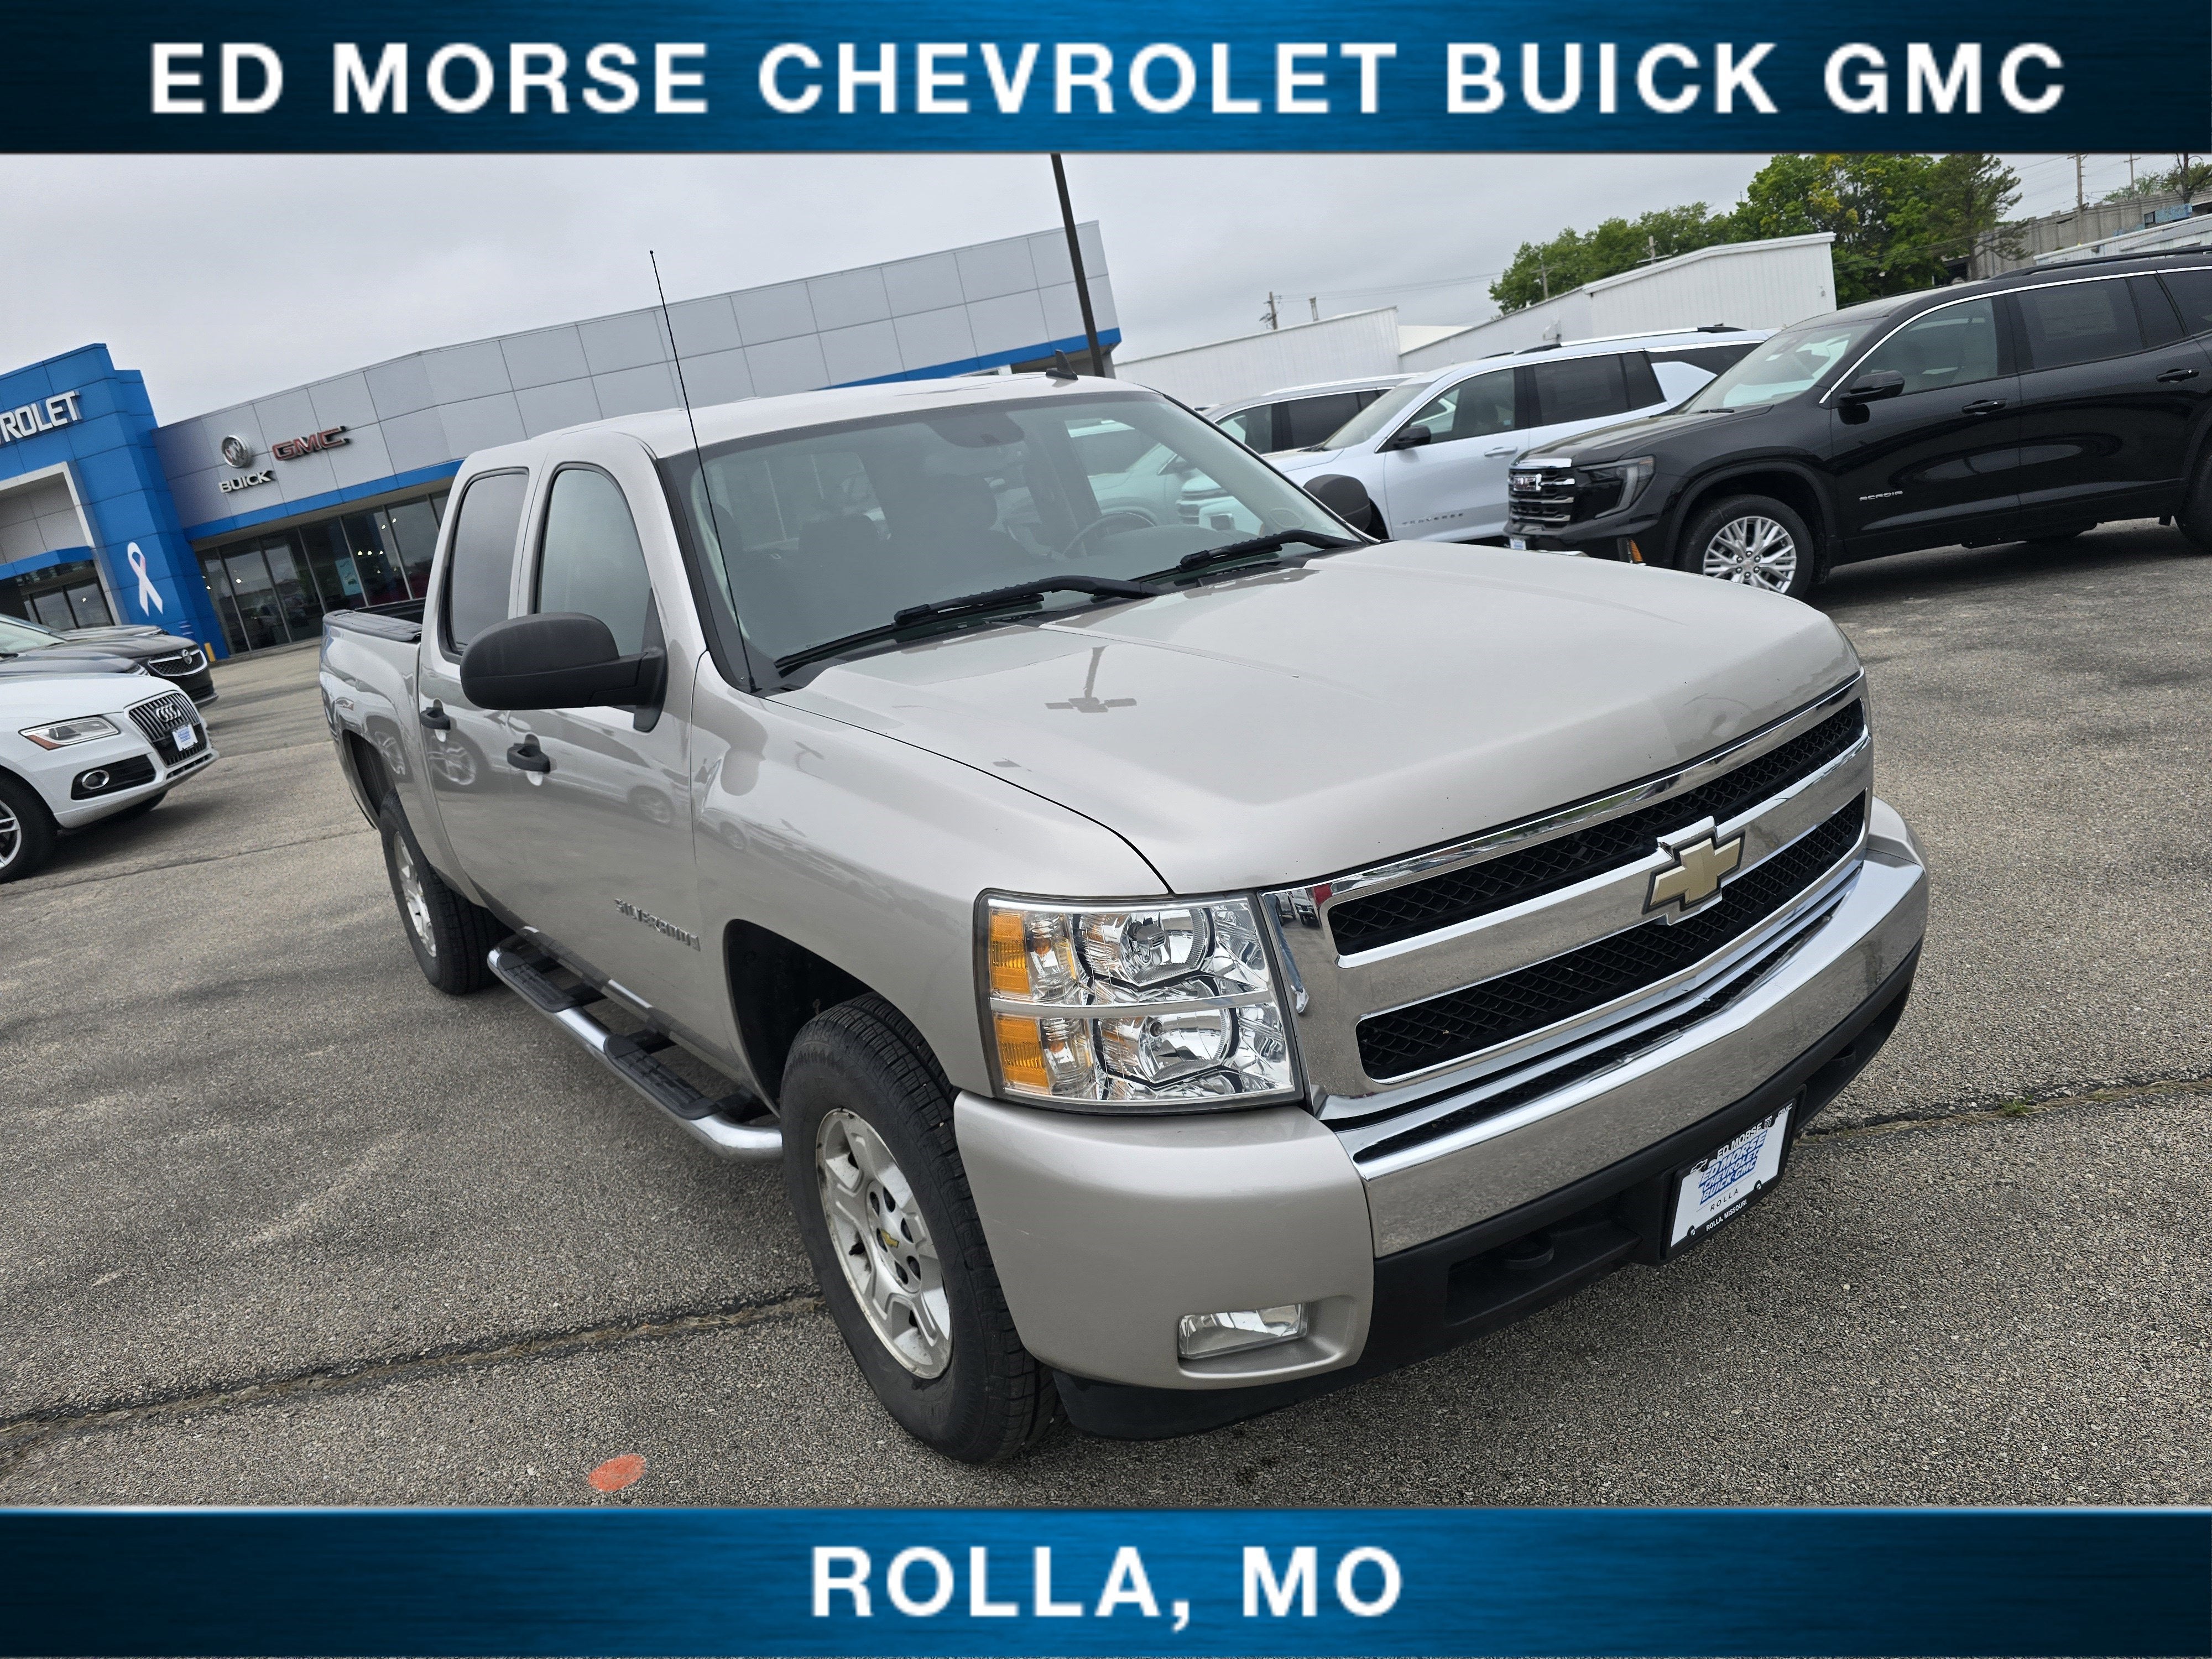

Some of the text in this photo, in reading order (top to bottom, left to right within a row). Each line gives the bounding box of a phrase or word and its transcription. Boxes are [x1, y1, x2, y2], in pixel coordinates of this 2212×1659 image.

[0, 390, 80, 442] ROLET
[272, 426, 347, 462] GMC
[218, 471, 273, 493] BUICK
[1717, 1144, 1729, 1157] ED
[1731, 1122, 1762, 1151] MORSE
[1699, 1130, 1767, 1186] ED MORSE
[1703, 1148, 1760, 1192] CHEVROLET
[1706, 1198, 1747, 1232] ROLLA, MISSOURI
[1710, 1188, 1738, 1212] ROLLA
